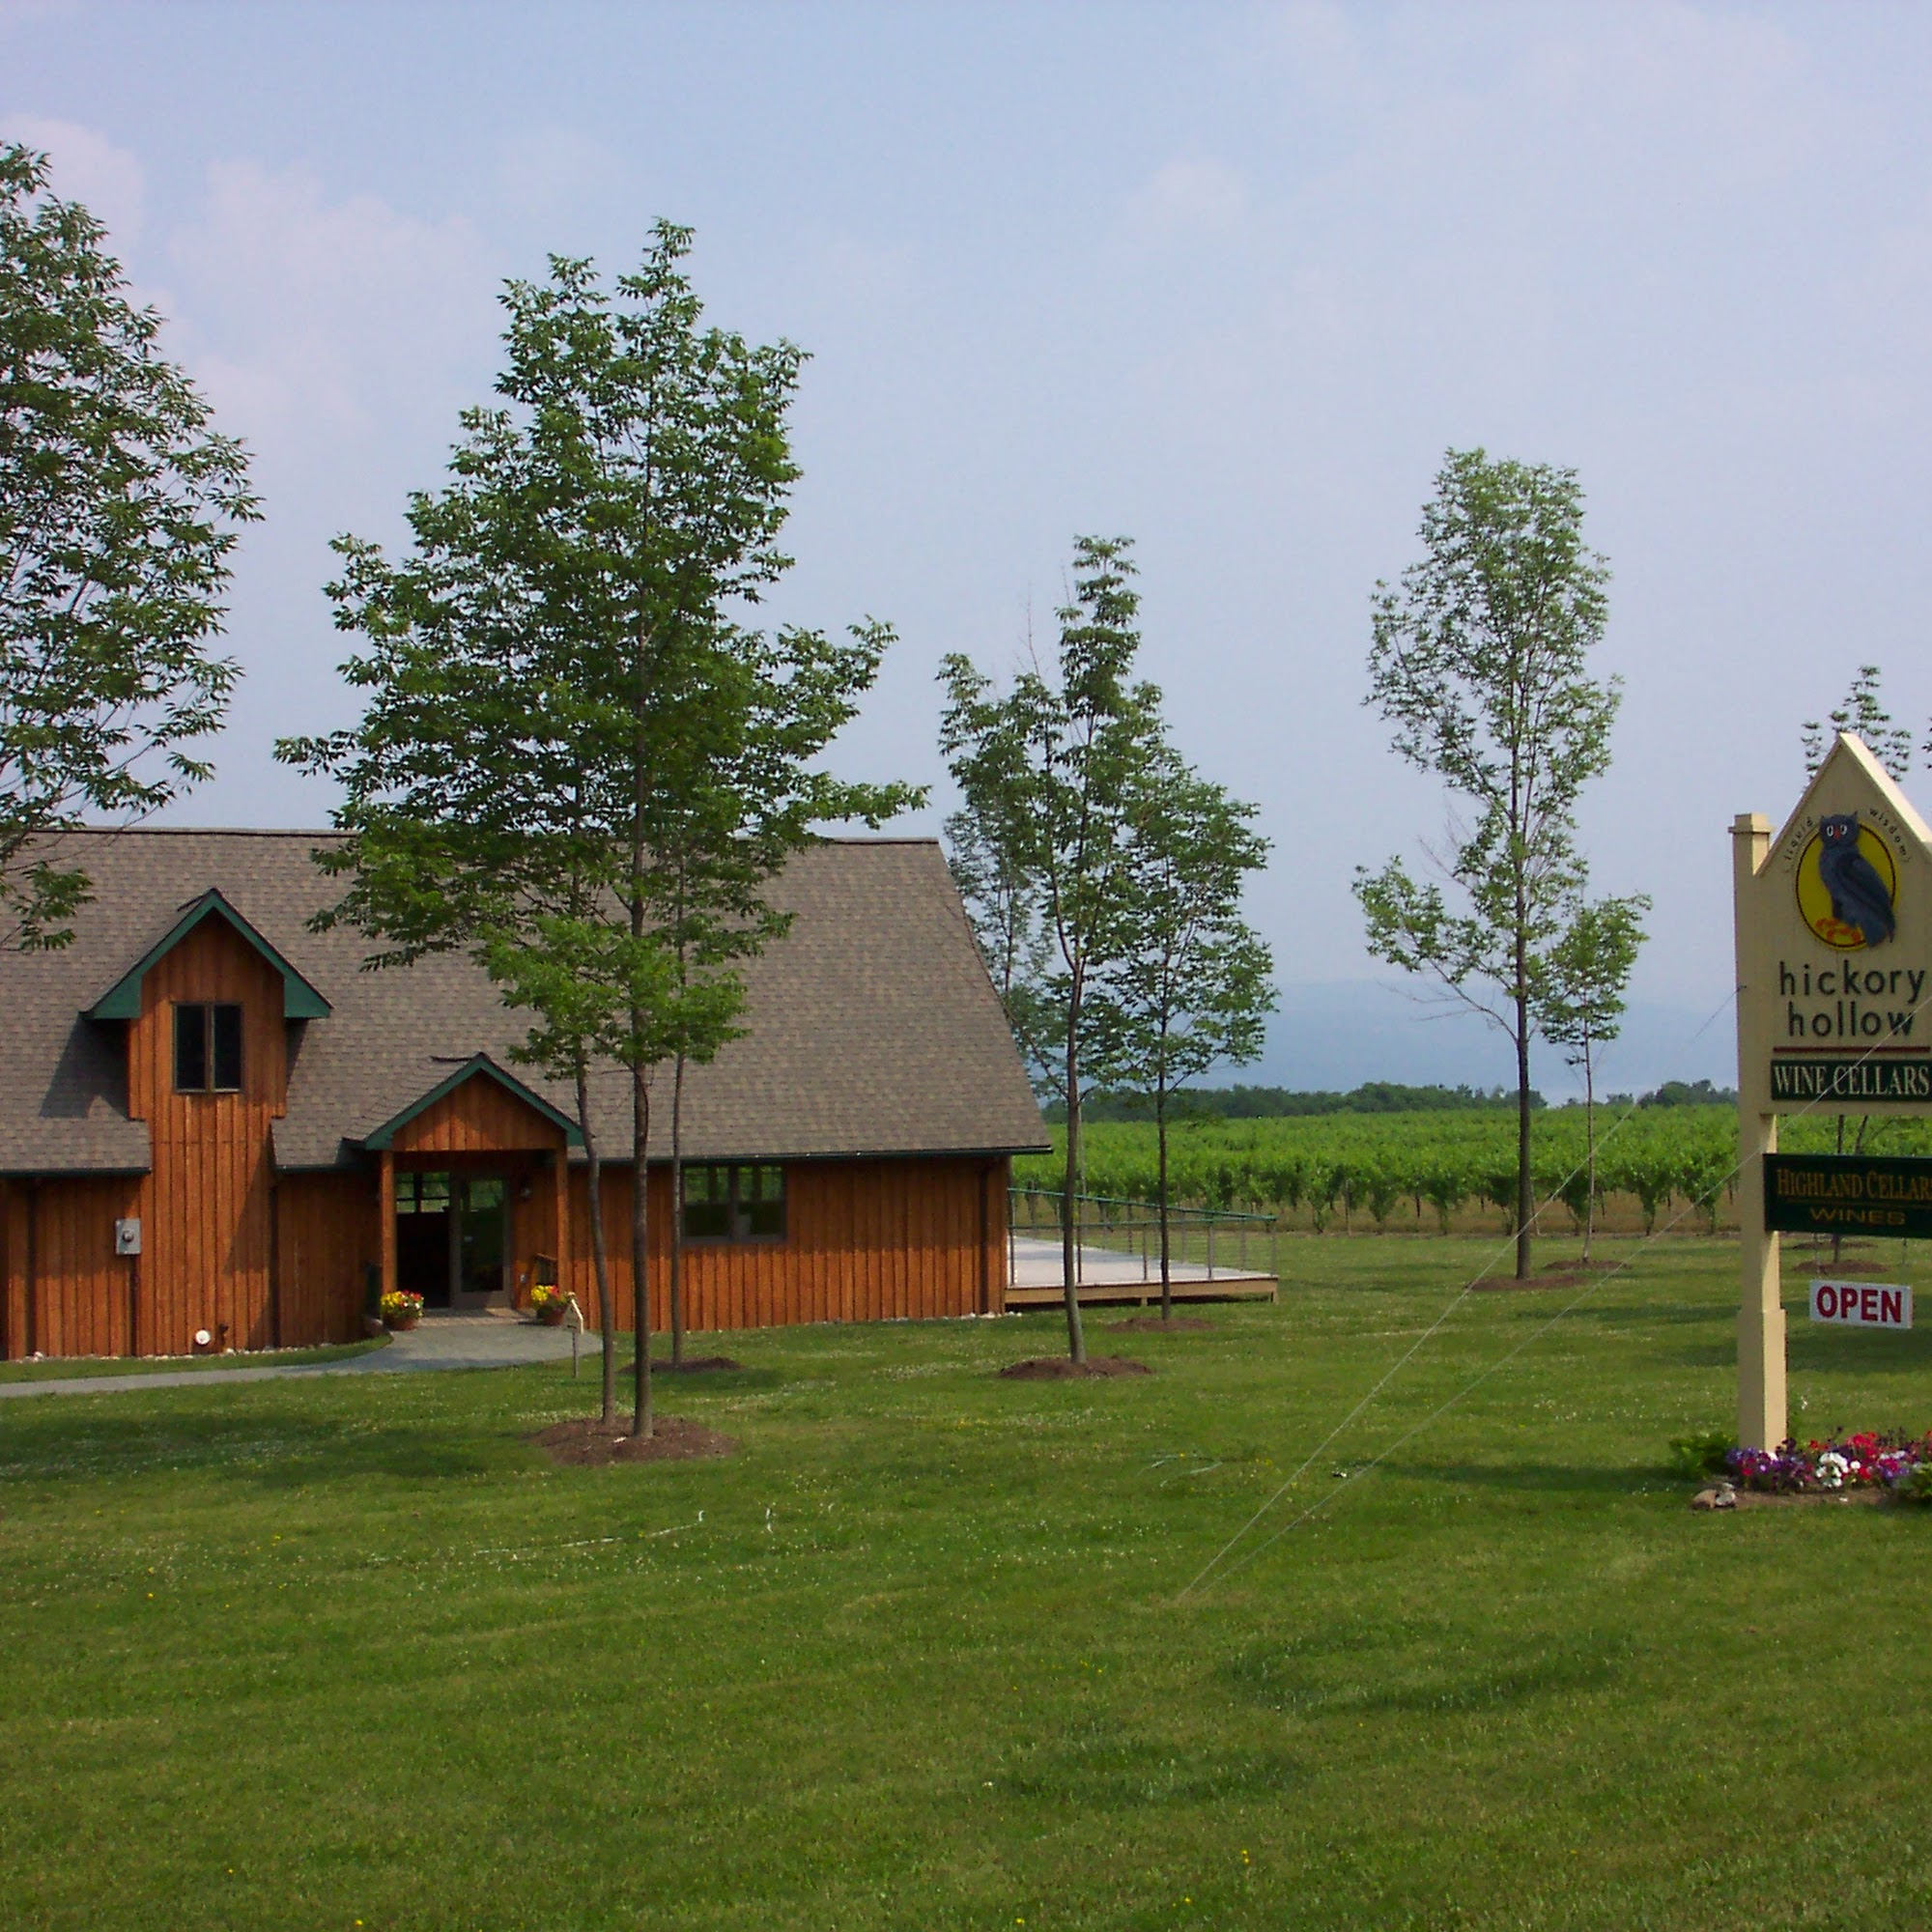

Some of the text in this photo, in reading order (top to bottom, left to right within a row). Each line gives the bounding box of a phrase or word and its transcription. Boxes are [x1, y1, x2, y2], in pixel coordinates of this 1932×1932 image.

[1783, 808, 1907, 861] liquid wisdom
[1779, 960, 1925, 1004] hickory
[1787, 1001, 1915, 1037] hollow
[1774, 1065, 1930, 1096] WINE CELLARS
[1776, 1169, 1932, 1201] HIGHLAND CELLAR
[1809, 1207, 1906, 1226] WINES
[1816, 1286, 1902, 1323] OPEN
